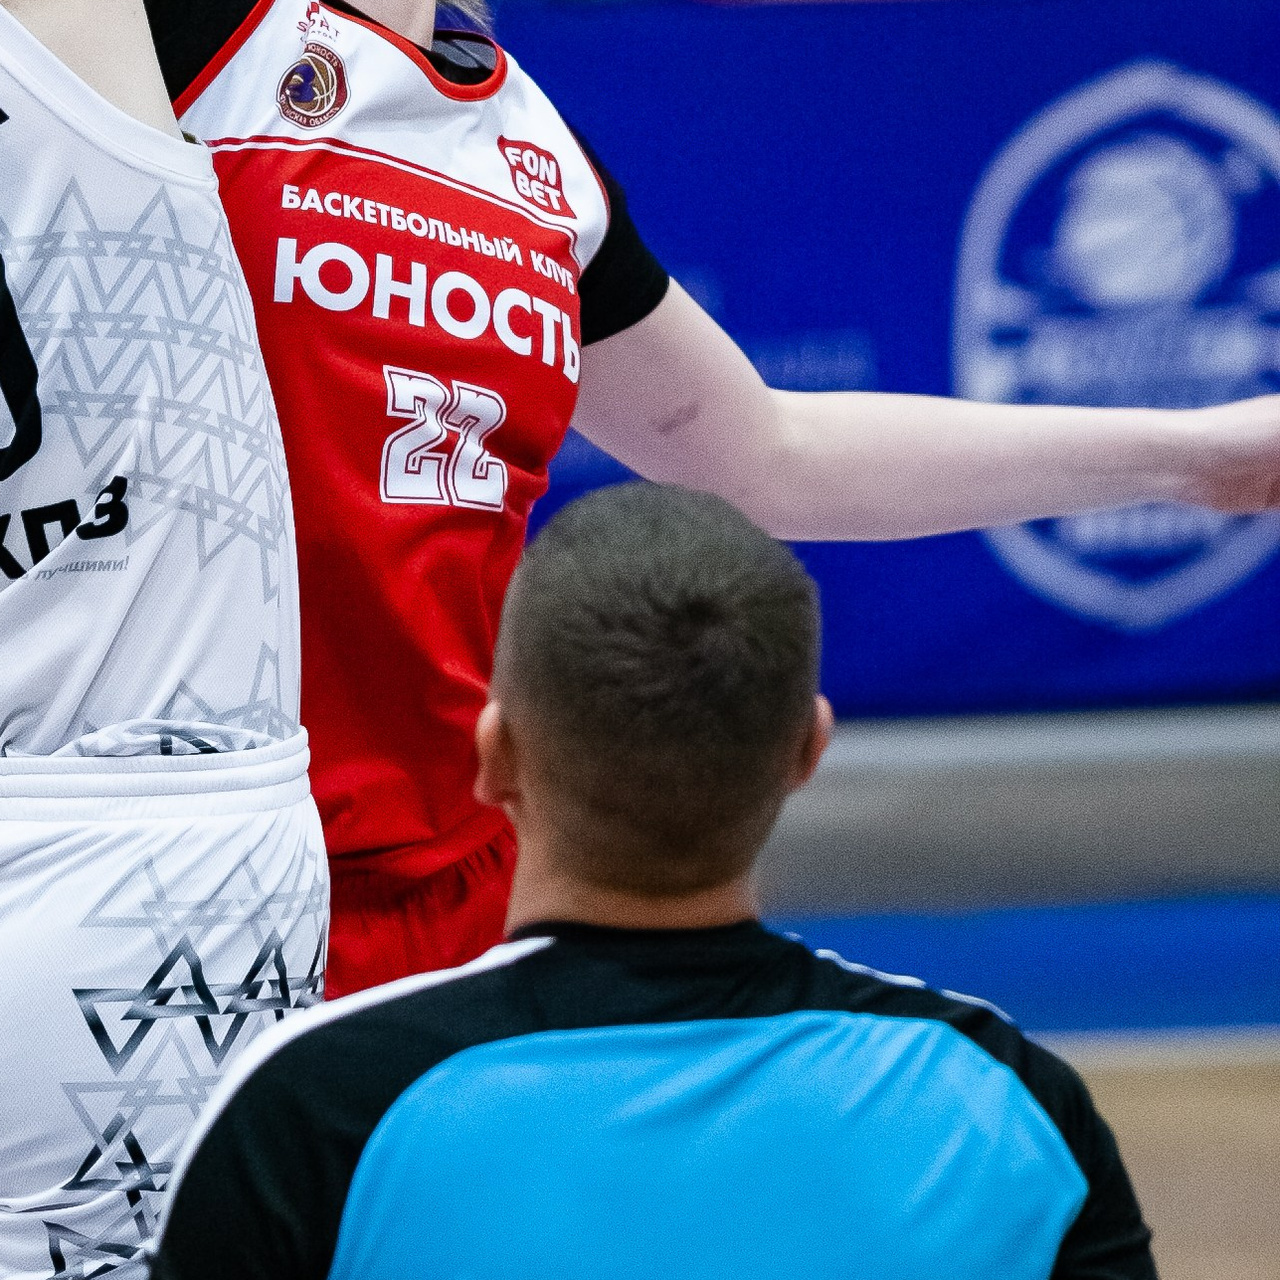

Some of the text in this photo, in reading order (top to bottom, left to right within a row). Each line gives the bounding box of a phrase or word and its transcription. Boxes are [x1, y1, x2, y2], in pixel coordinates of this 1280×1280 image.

[504, 146, 558, 187] FON
[515, 169, 562, 212] BET
[281, 183, 576, 295] БАСКЕТБОЛЬНЫЙ КЛУБ
[273, 237, 581, 385] ЮНОСТЬ
[379, 364, 509, 513] 22
